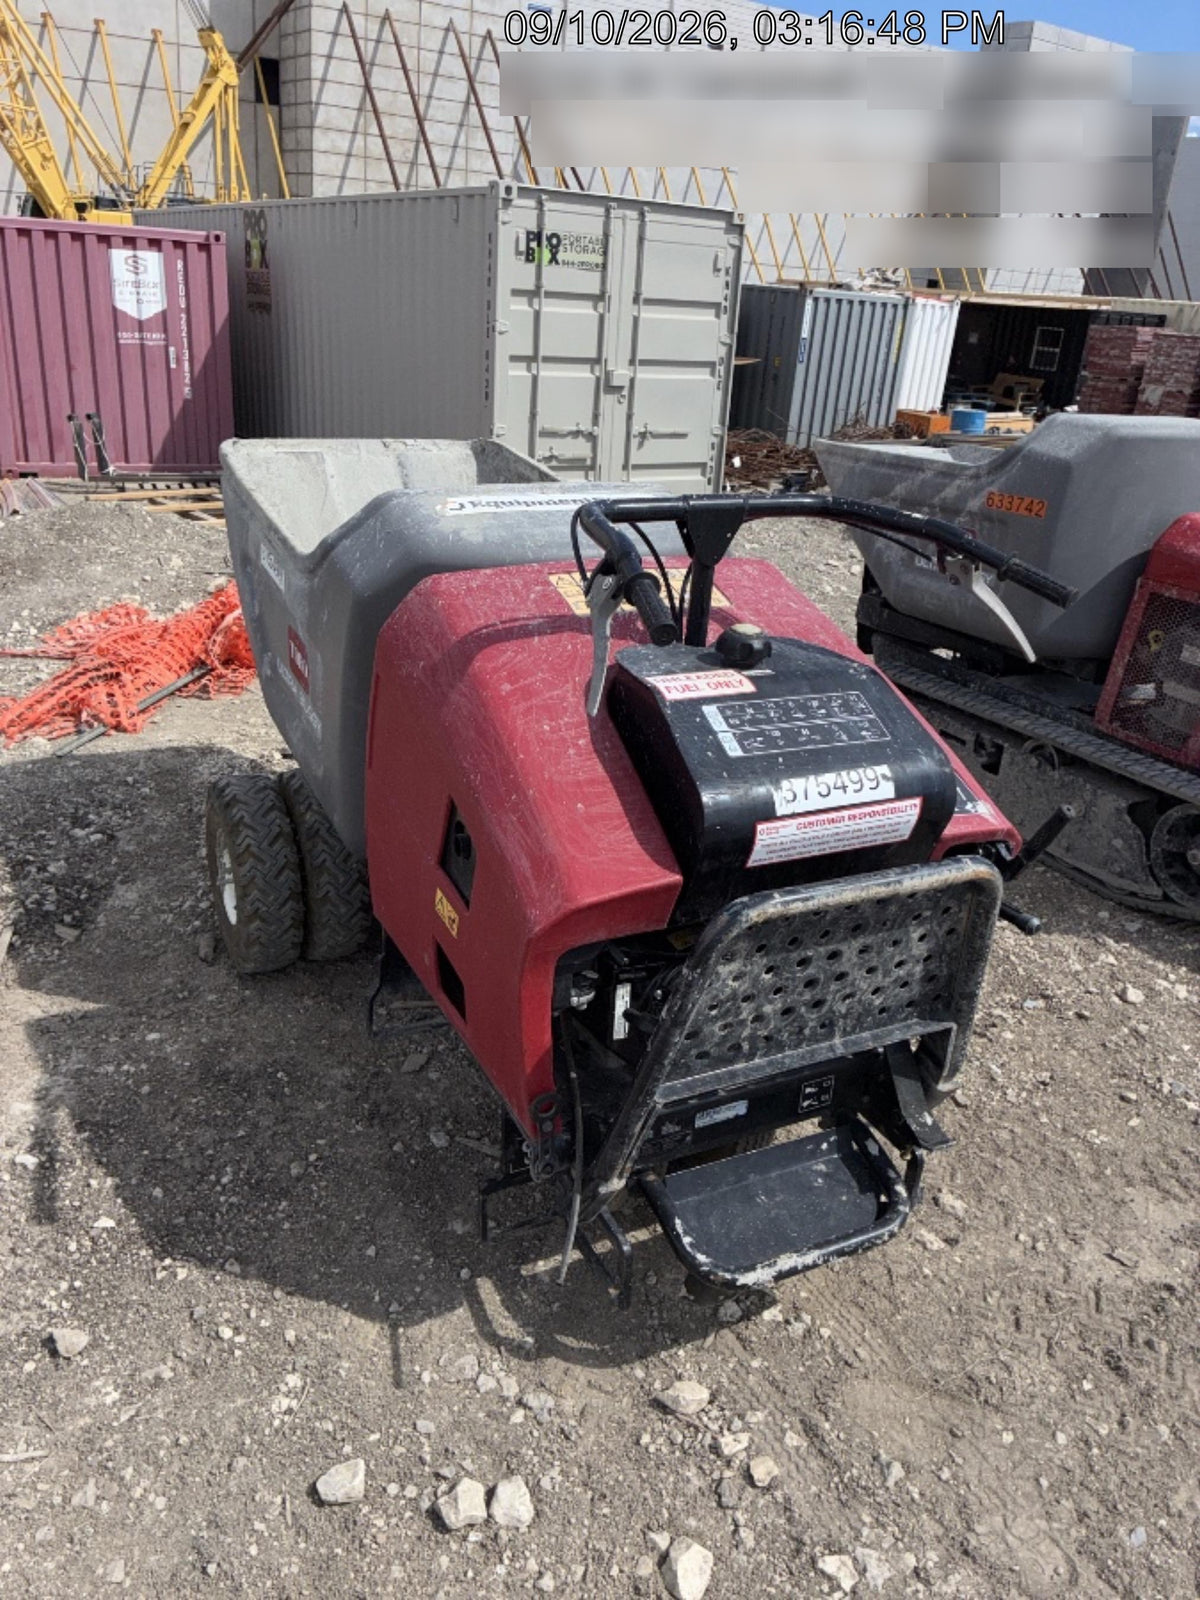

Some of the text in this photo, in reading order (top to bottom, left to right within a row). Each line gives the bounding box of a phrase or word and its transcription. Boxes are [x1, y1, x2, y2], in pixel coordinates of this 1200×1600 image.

[562, 243, 605, 257] STORAG
[986, 491, 1046, 518] 633742
[664, 678, 745, 694] FUEL ONLY
[782, 766, 881, 804] 375499
